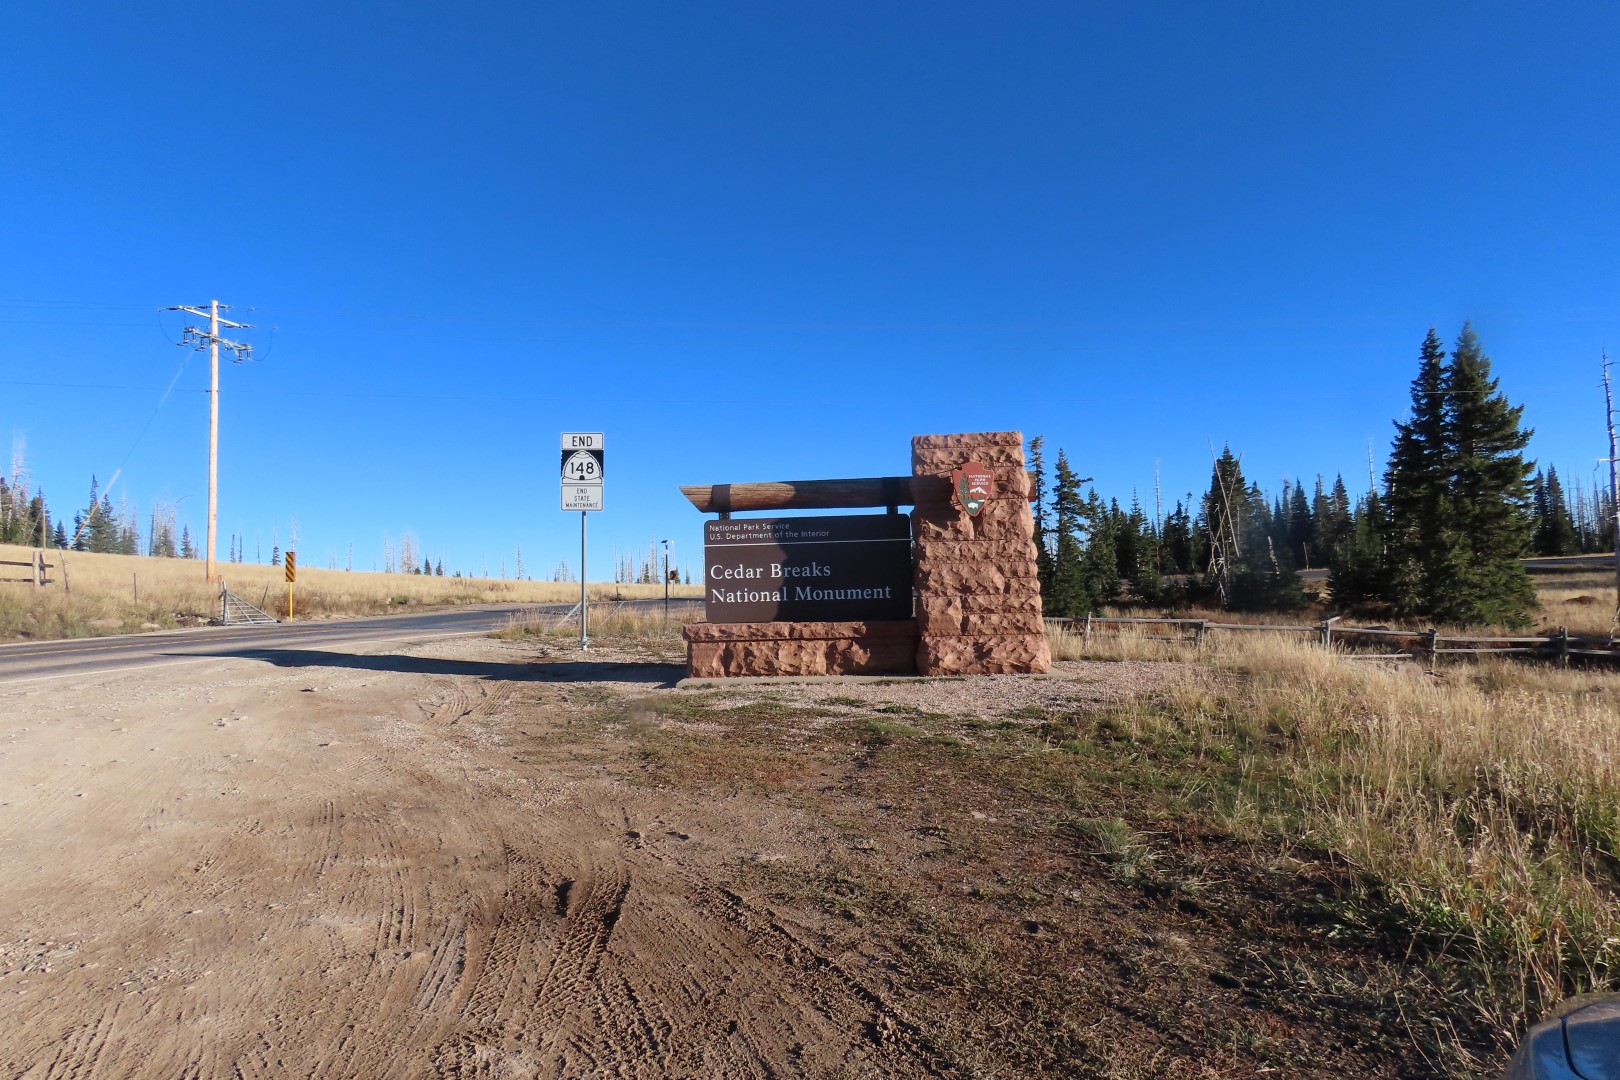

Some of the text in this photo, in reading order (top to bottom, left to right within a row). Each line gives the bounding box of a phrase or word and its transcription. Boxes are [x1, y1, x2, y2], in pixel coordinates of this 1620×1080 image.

[572, 436, 593, 447] END
[570, 462, 594, 474] 148
[726, 532, 772, 540] Department
[710, 562, 831, 580] Cedar Breaks
[712, 586, 892, 603] National Monument
